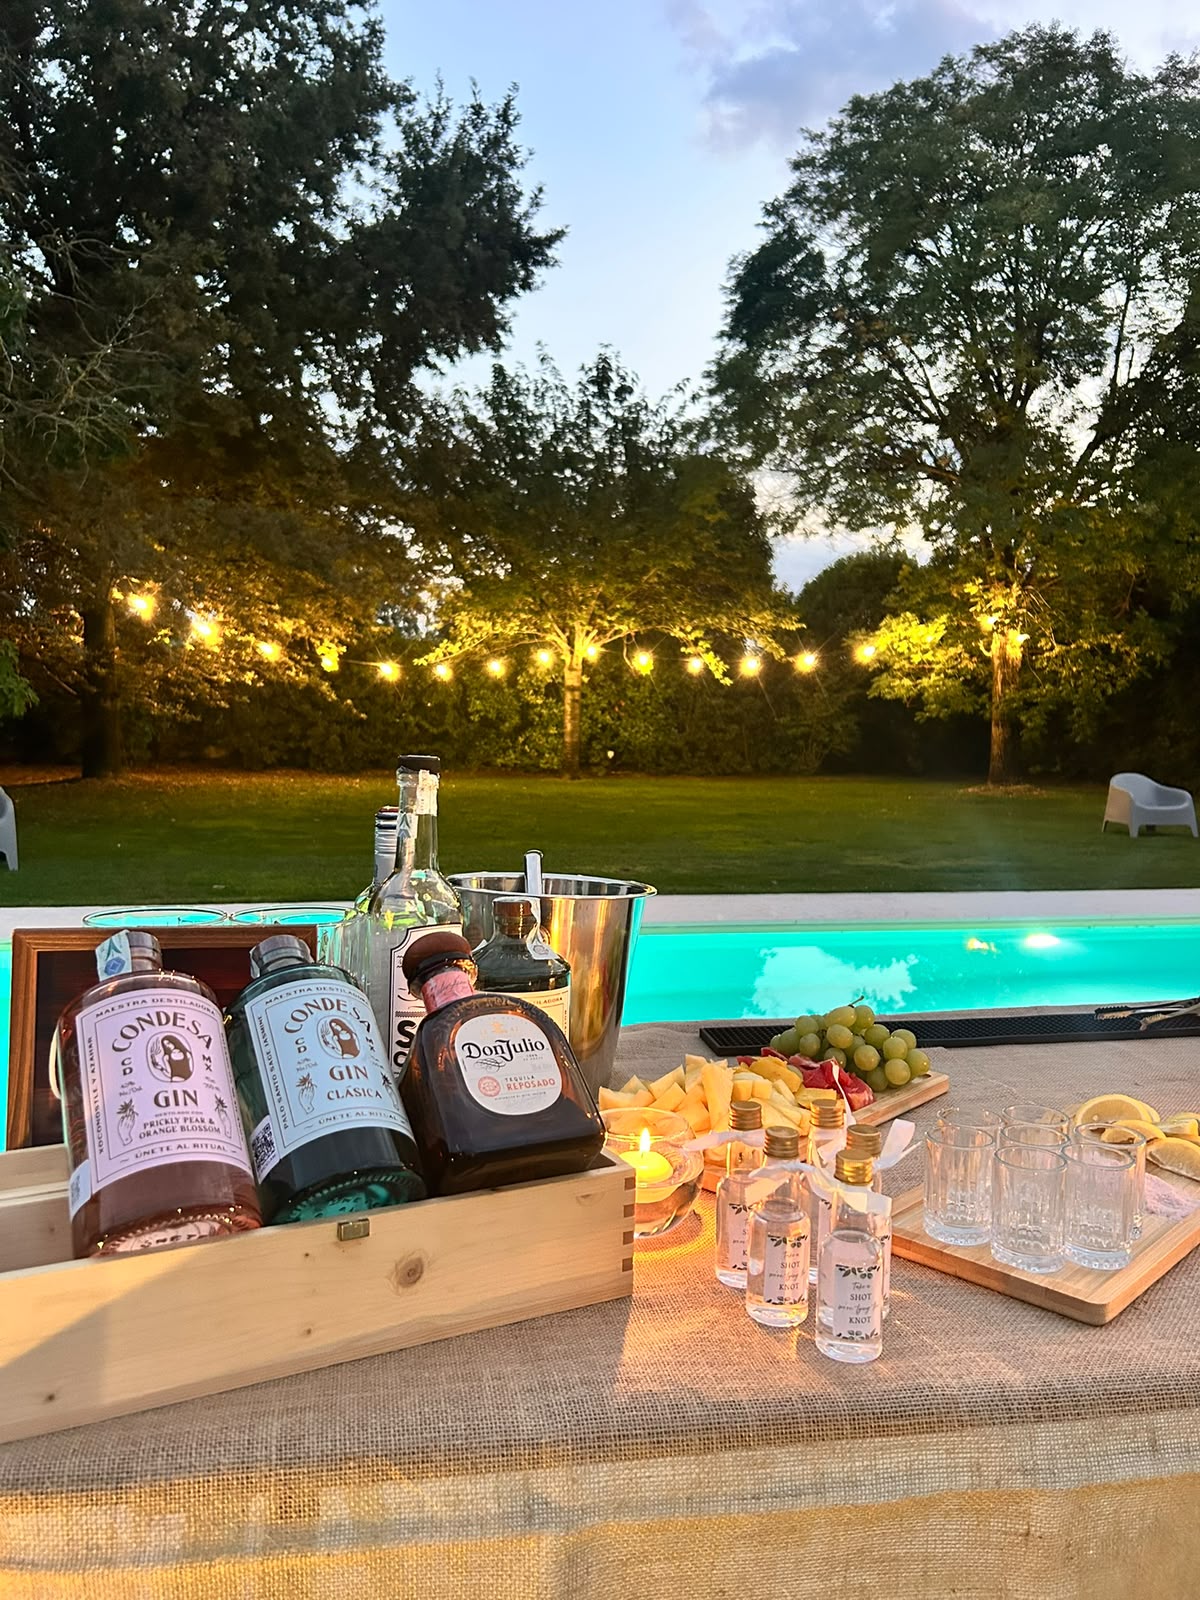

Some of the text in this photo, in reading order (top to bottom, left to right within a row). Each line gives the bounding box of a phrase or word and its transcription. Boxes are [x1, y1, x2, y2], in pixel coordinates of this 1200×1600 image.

[265, 986, 368, 1005] MAESTRA DESTILADORA
[95, 998, 216, 1018] MAESTRA DESTILADORA
[284, 997, 371, 1034] CONDESA
[111, 1010, 213, 1053] CONDESA
[265, 1050, 275, 1073] SAGE
[329, 1065, 369, 1081] GIN
[272, 1074, 282, 1104] SANTO
[506, 1078, 556, 1091] REPOSADO
[153, 1089, 198, 1108] GIN
[327, 1085, 382, 1101] CLÁSICA
[143, 1116, 180, 1130] PRICKLY
[183, 1116, 206, 1125] PEAR
[279, 1105, 289, 1130] PALO
[318, 1111, 352, 1124] ÚNETE
[138, 1124, 221, 1140] ORANGE BLOSSOM
[135, 1144, 173, 1158] ÚNETE
[193, 1143, 228, 1152] RITUAL
[780, 1261, 800, 1269] SHOT
[779, 1283, 799, 1291] KNOT
[849, 1293, 872, 1301] SHOT
[848, 1316, 872, 1324] KNOT
